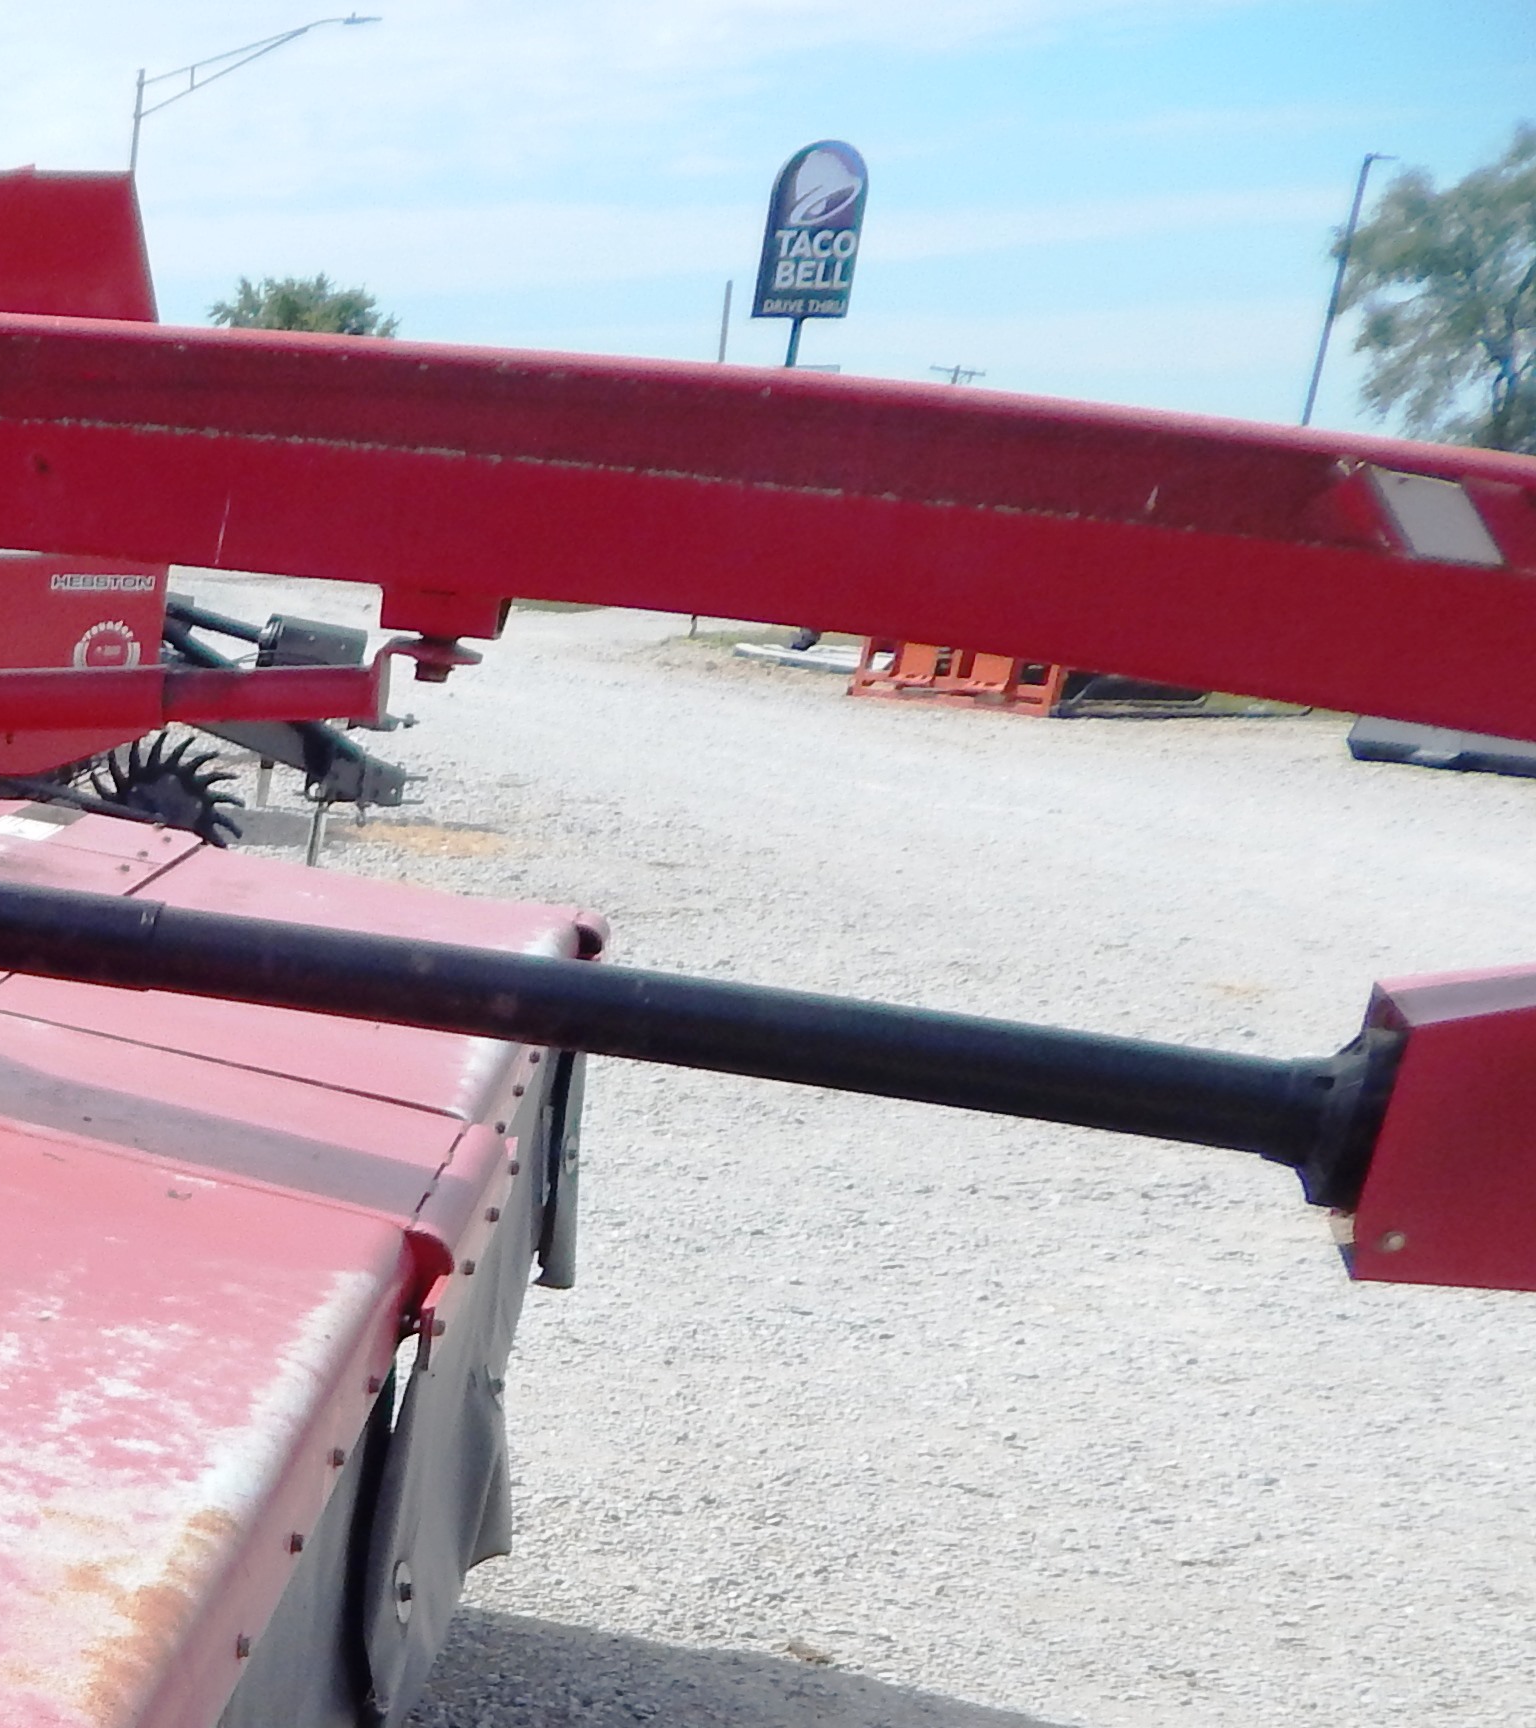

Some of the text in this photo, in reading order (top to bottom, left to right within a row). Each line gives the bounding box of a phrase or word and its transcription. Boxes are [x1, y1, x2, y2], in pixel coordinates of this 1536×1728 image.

[775, 229, 858, 259] TACO
[774, 260, 849, 290] BELL
[762, 299, 804, 313] DRIVE
[51, 574, 156, 590] HESSTON
